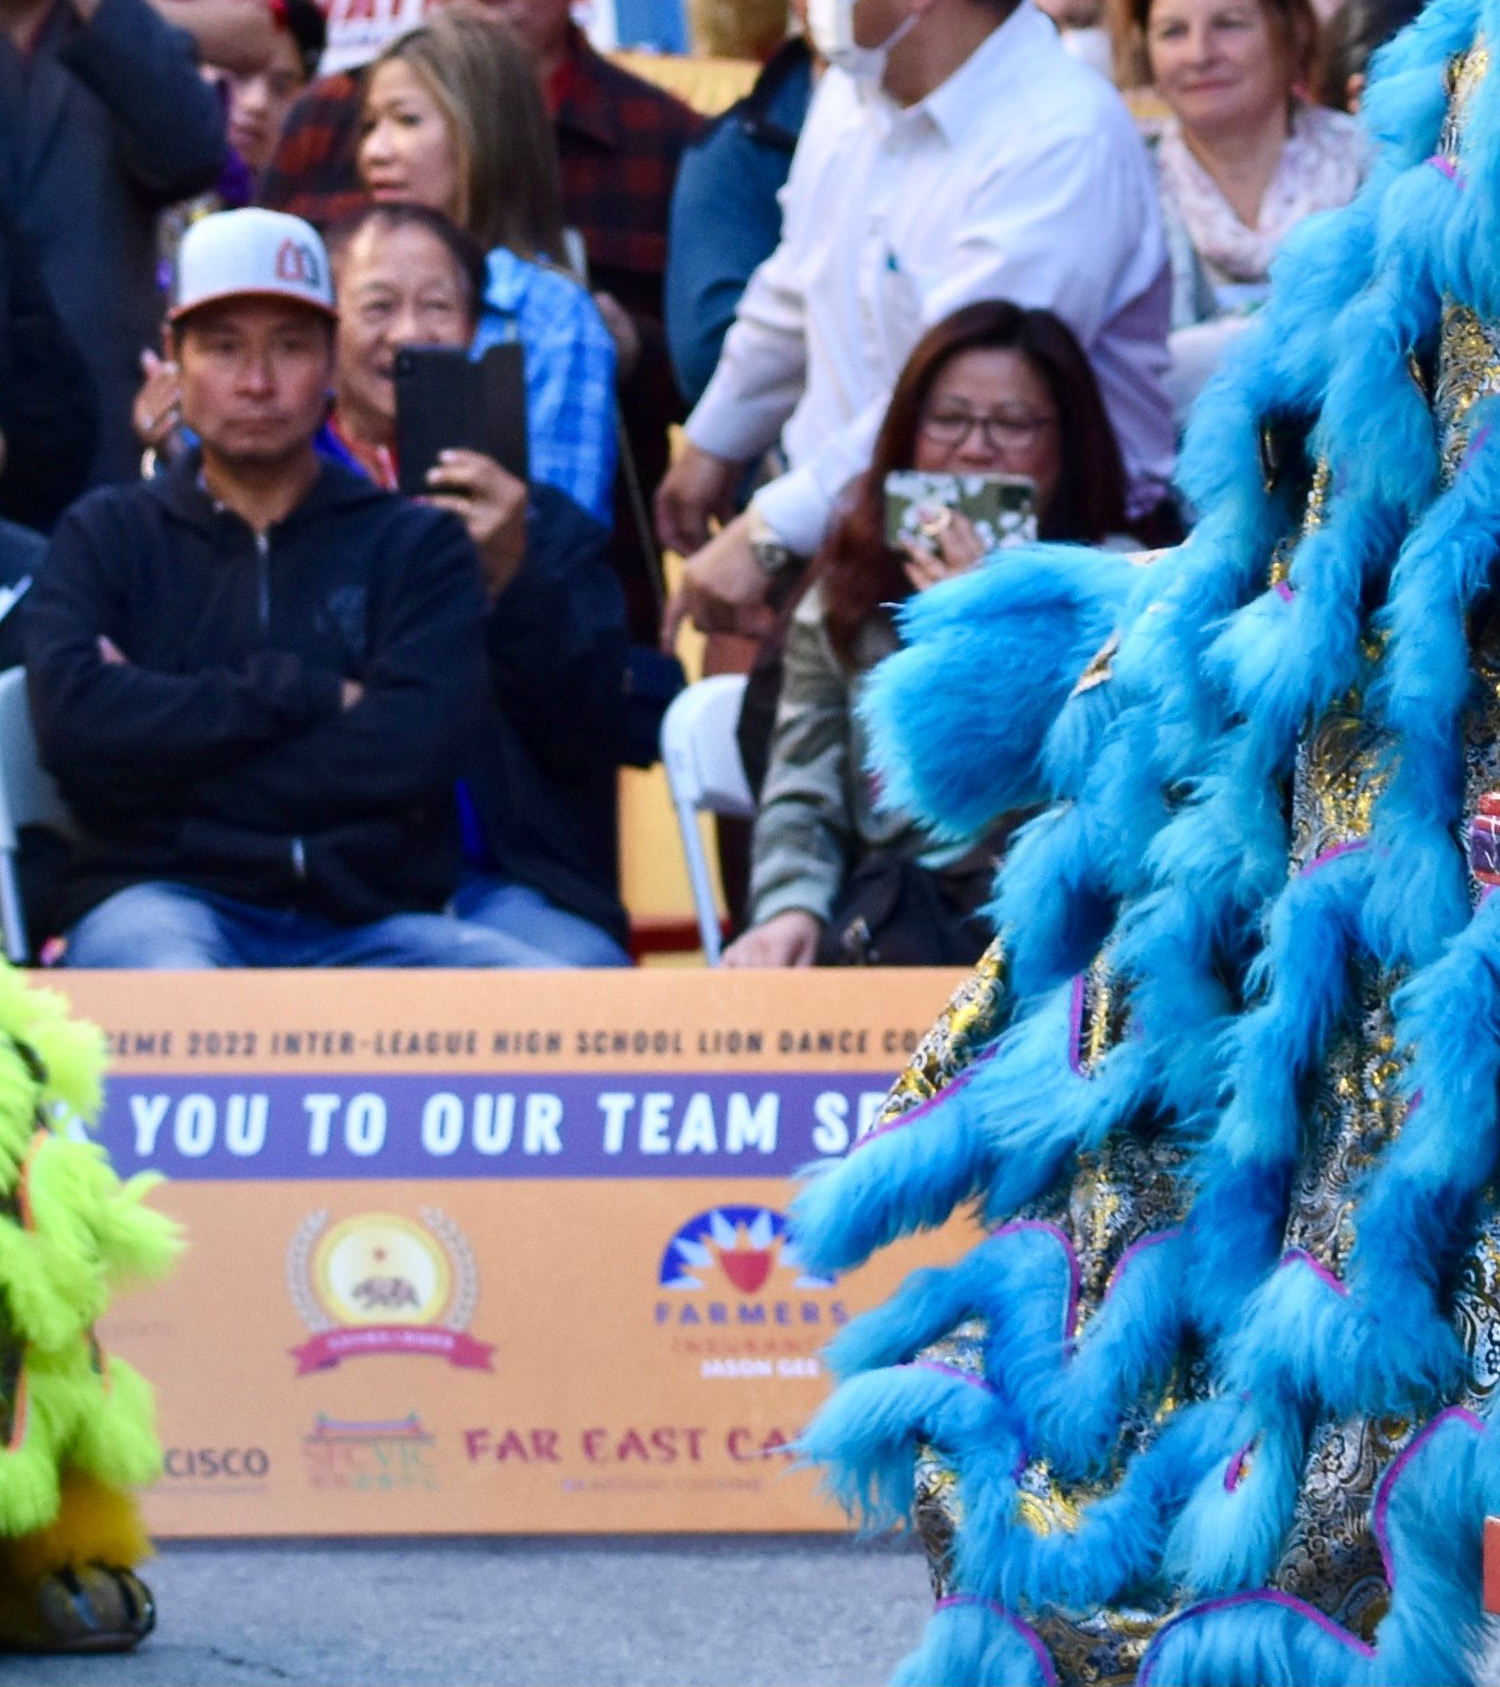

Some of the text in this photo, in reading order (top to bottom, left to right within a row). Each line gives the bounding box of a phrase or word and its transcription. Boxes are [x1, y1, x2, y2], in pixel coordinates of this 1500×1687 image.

[187, 1030, 257, 1058] 2022
[271, 1029, 478, 1057] INTER-LEAGUE
[492, 1029, 563, 1057] HIGH
[576, 1029, 684, 1056] SCHOOL
[700, 1029, 764, 1056] LION
[778, 1029, 870, 1056] DANCE
[129, 1092, 270, 1158] YOU
[303, 1092, 388, 1158] TO
[421, 1091, 564, 1157] OUR
[598, 1091, 781, 1156] TEAM
[654, 1301, 849, 1327] FARMERS
[462, 1427, 562, 1464] FAR
[582, 1427, 706, 1464] EAST
